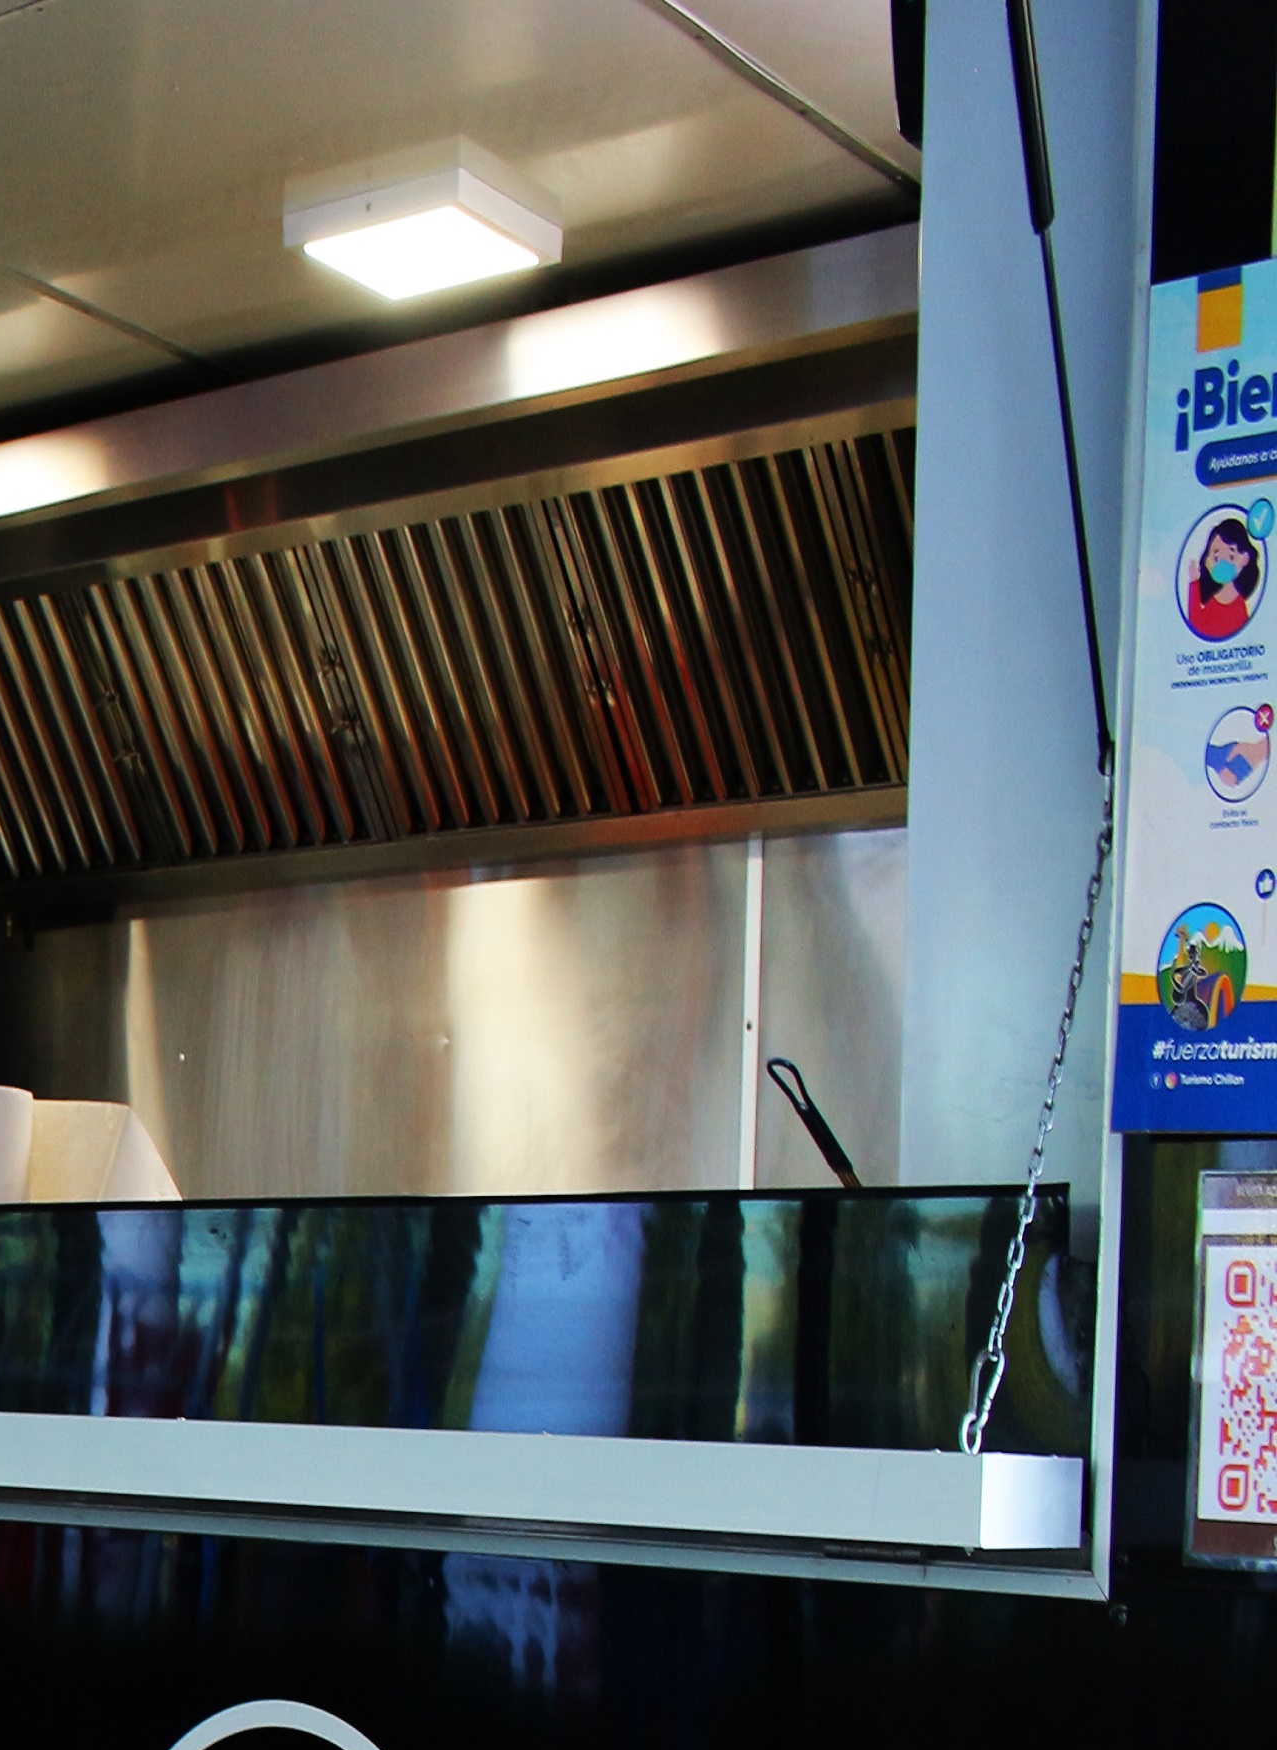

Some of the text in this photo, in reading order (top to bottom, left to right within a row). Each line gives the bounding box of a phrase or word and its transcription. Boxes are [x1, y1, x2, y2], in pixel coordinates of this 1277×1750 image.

[1175, 359, 1277, 453] ¡Bie
[1197, 644, 1266, 664] OBLIGATORIO
[1180, 1072, 1213, 1086] Turismo
